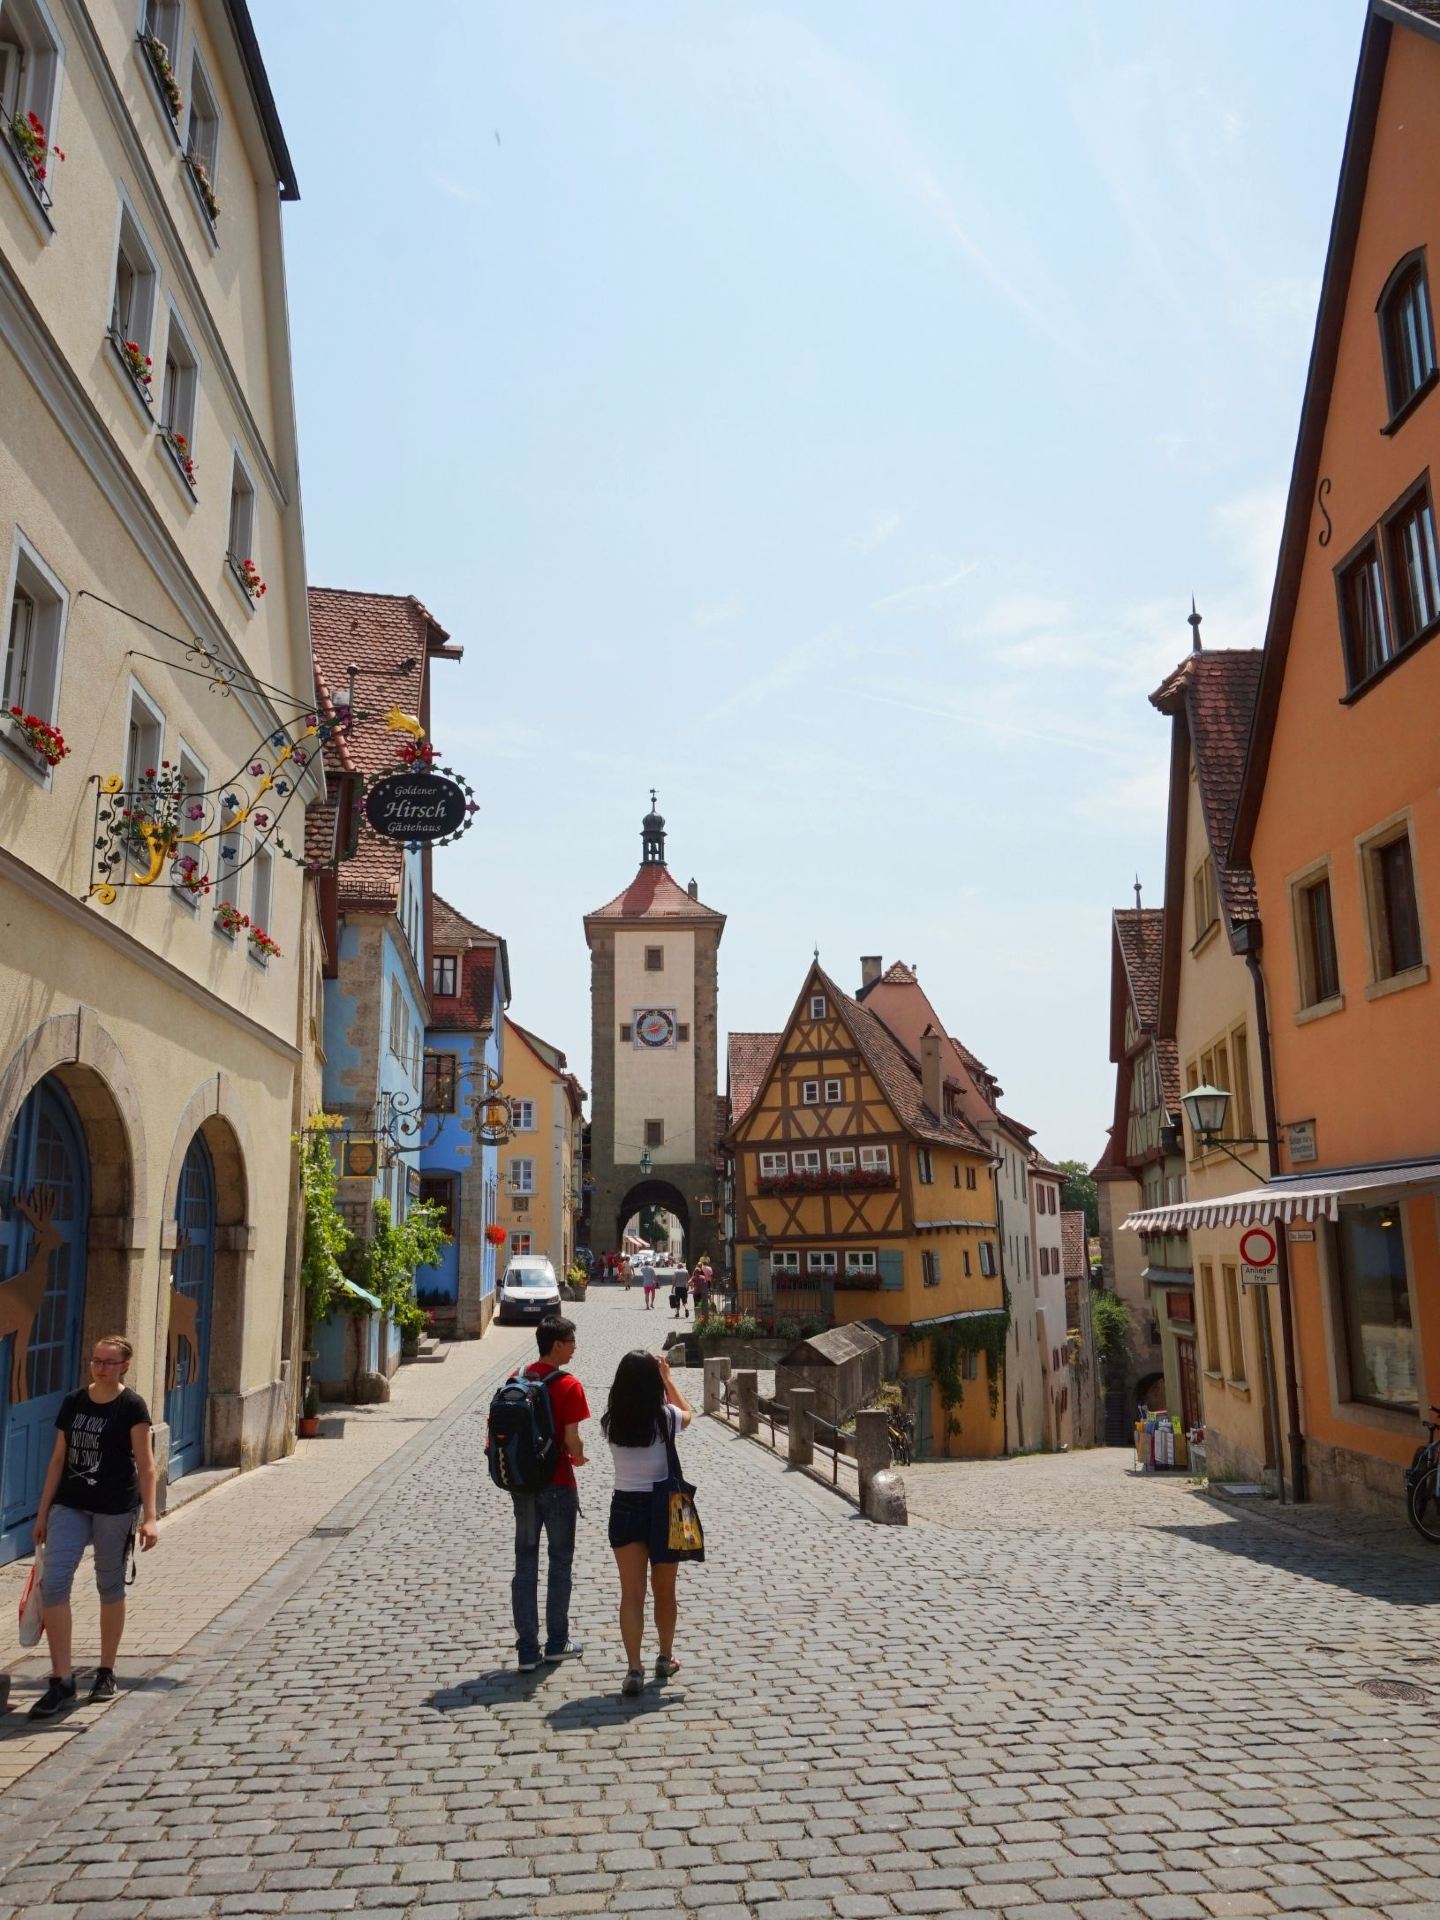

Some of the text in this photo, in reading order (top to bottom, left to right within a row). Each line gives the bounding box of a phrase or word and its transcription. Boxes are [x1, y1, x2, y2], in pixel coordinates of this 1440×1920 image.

[394, 784, 438, 797] Goldener
[383, 799, 447, 818] Hirsch
[387, 820, 442, 834] Gästehaus
[1246, 1267, 1275, 1275] Anlieger
